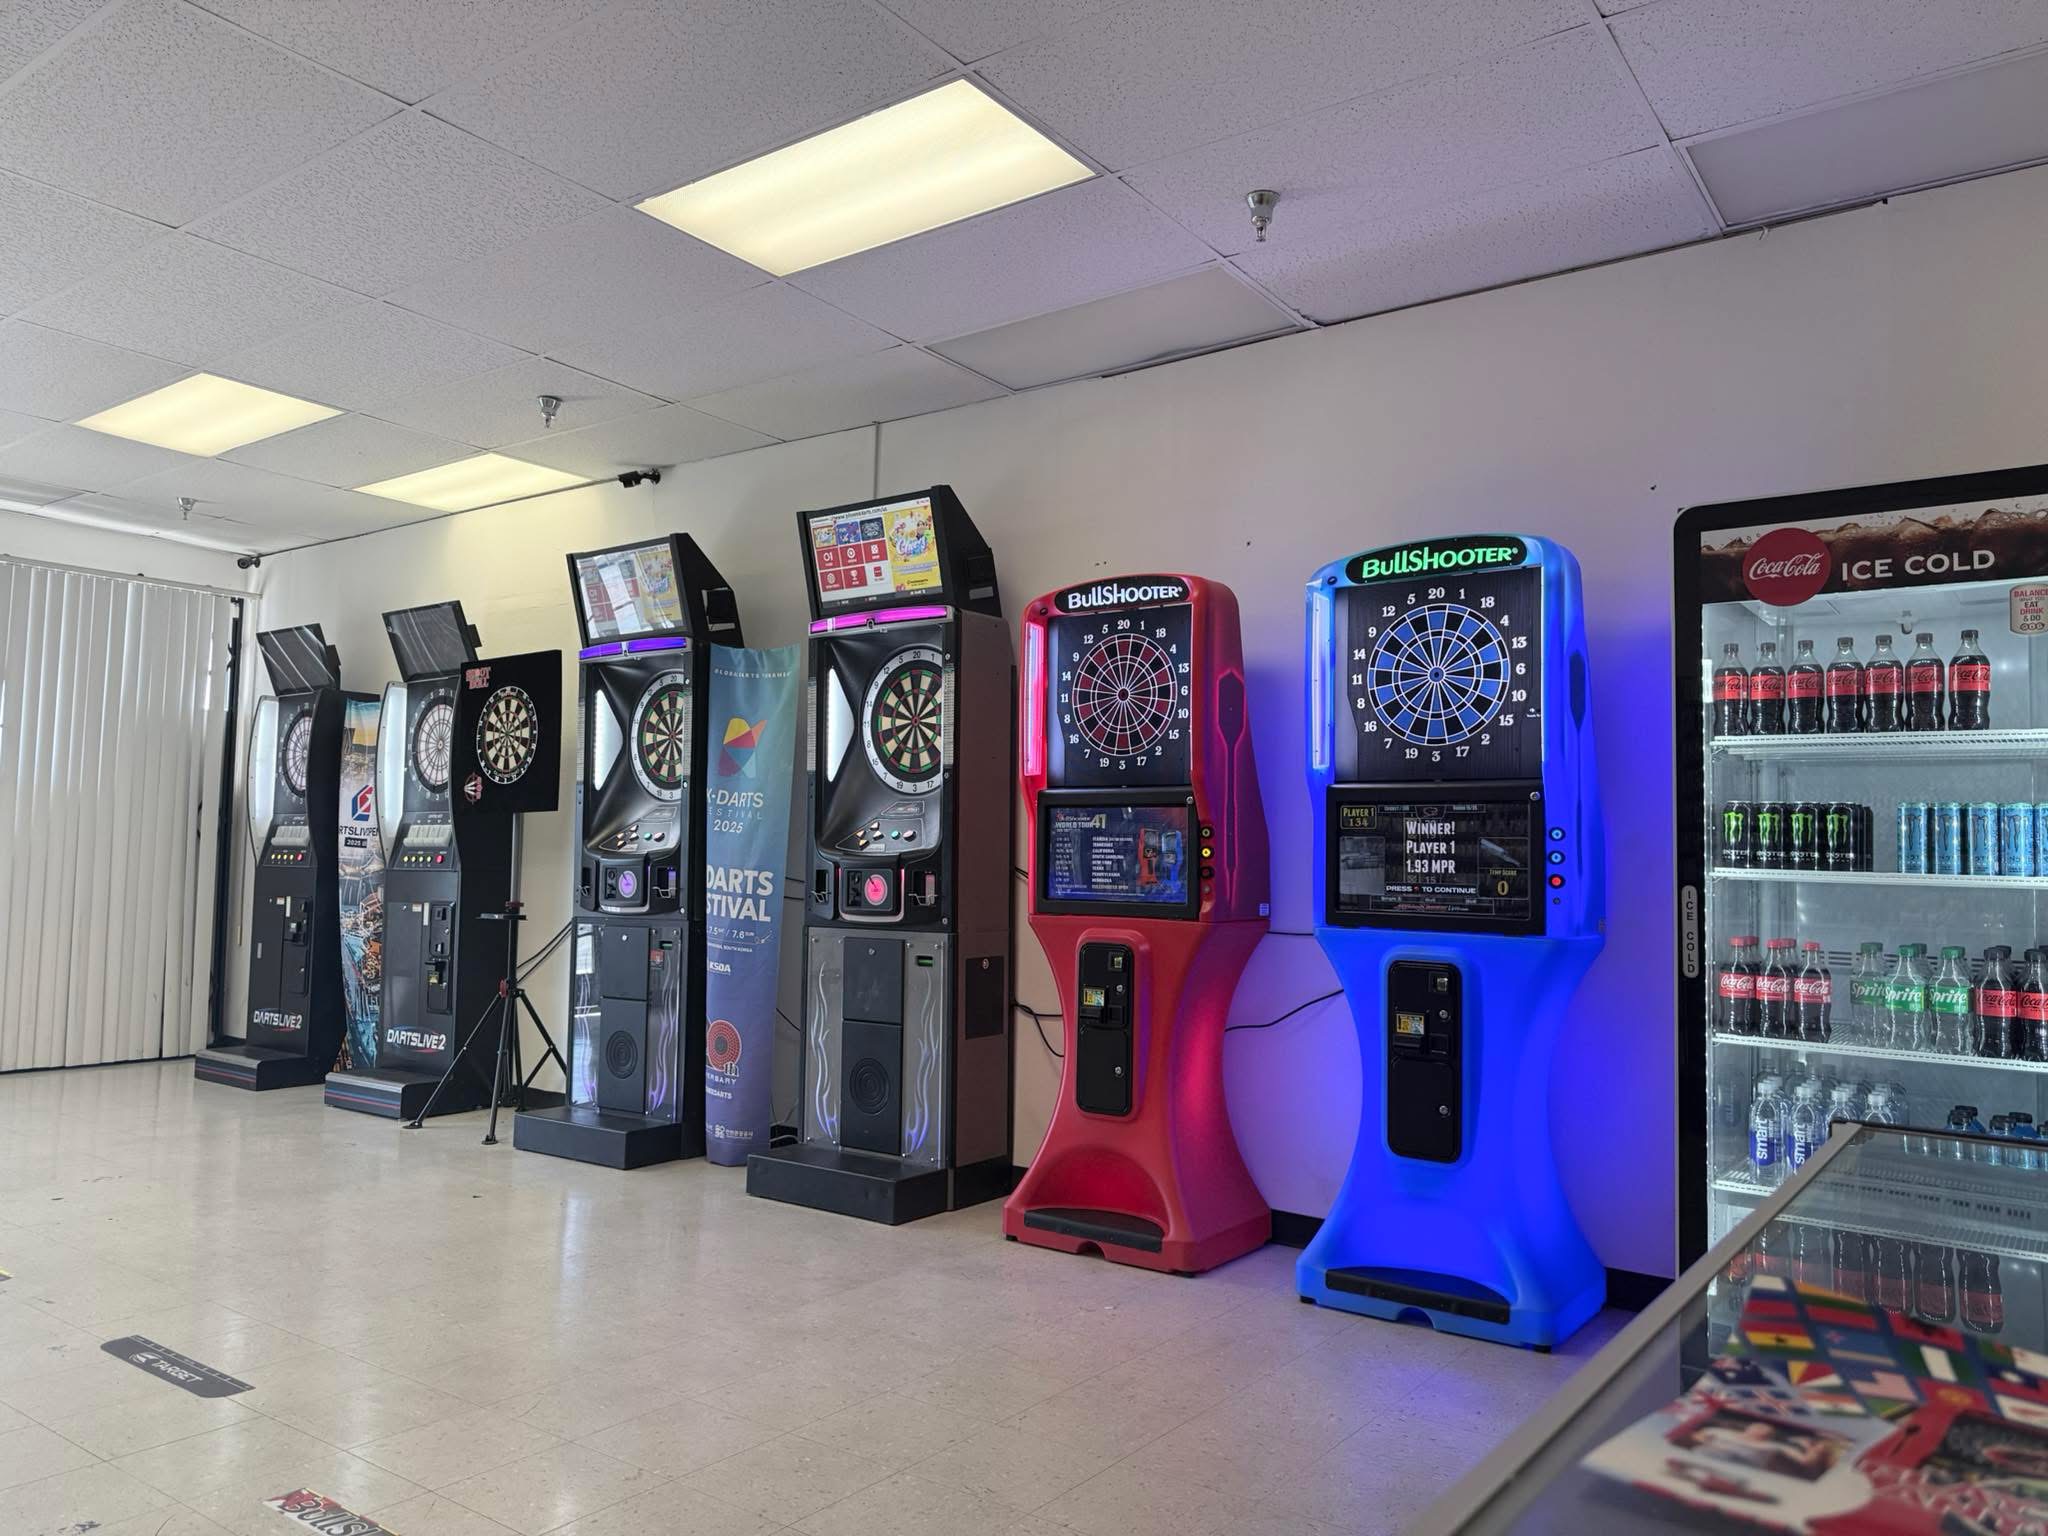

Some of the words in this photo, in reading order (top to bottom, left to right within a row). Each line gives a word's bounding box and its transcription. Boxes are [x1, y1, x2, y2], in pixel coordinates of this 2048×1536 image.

[1749, 552, 1825, 580] Coca-Cola
[1842, 558, 1893, 581] ICE
[1904, 550, 1995, 576] COLD
[1428, 587, 1445, 599] 20
[1459, 588, 1465, 600] 1
[1407, 594, 1416, 604] 5
[1480, 596, 1495, 608] 18
[1382, 606, 1396, 617] 12
[1117, 620, 1130, 629] 20
[1141, 621, 1145, 630] 1
[1500, 615, 1510, 626] 4
[1102, 624, 1109, 634] 5
[1156, 628, 1166, 638] 18
[1368, 627, 1377, 638] 9
[1084, 634, 1094, 644] 12
[1512, 637, 1527, 649] 13
[1170, 644, 1177, 654] 4
[1353, 648, 1366, 660] 14
[1073, 652, 1079, 661] 9
[883, 667, 890, 675] 12
[1178, 663, 1189, 673] 13
[1516, 663, 1526, 675] 6
[1062, 671, 1071, 680] 14
[1352, 674, 1363, 685] 11
[874, 681, 879, 689] 9
[1181, 686, 1188, 696] 6
[1511, 689, 1527, 701] 10
[1061, 694, 1069, 703] 11
[1357, 698, 1366, 709] 8
[1064, 714, 1071, 723] 8
[1178, 709, 1189, 719] 10
[1499, 714, 1514, 726] 15
[1364, 721, 1377, 732] 16
[1070, 734, 1079, 744] 16
[1169, 730, 1179, 739] 15
[1481, 734, 1490, 745] 2
[866, 740, 871, 748] 8
[1384, 738, 1393, 749] 7
[1084, 749, 1090, 758] 7
[1155, 746, 1162, 755] 2
[1405, 748, 1418, 759] 19
[1432, 750, 1441, 762] 3
[1456, 746, 1470, 757] 17
[1100, 758, 1109, 767] 19
[1119, 760, 1126, 770] 3
[1137, 756, 1147, 766] 17
[883, 772, 888, 780] 7
[896, 781, 904, 789] 19
[912, 783, 917, 792] 3
[927, 780, 934, 789] 17
[1343, 808, 1370, 817] PLAYER
[713, 819, 744, 834] 2025
[1092, 814, 1106, 829] 41
[1406, 821, 1456, 835] WINNER!
[1406, 840, 1448, 854] PLAYER
[1450, 841, 1455, 854] 1
[1406, 859, 1429, 873] 1.93
[1432, 859, 1456, 874] MPR
[1497, 880, 1509, 896] 0
[1686, 891, 1694, 921] ICE
[1686, 932, 1695, 973] COLD
[1885, 987, 1922, 1003] Sprite
[1930, 988, 1967, 1003] Sprite
[253, 1010, 302, 1029] DARTSLIVE2
[387, 1029, 447, 1050] DARTSLIVE2
[1755, 1118, 1768, 1159] smart
[1794, 1122, 1805, 1164] smart
[152, 1360, 203, 1382] TARGET
